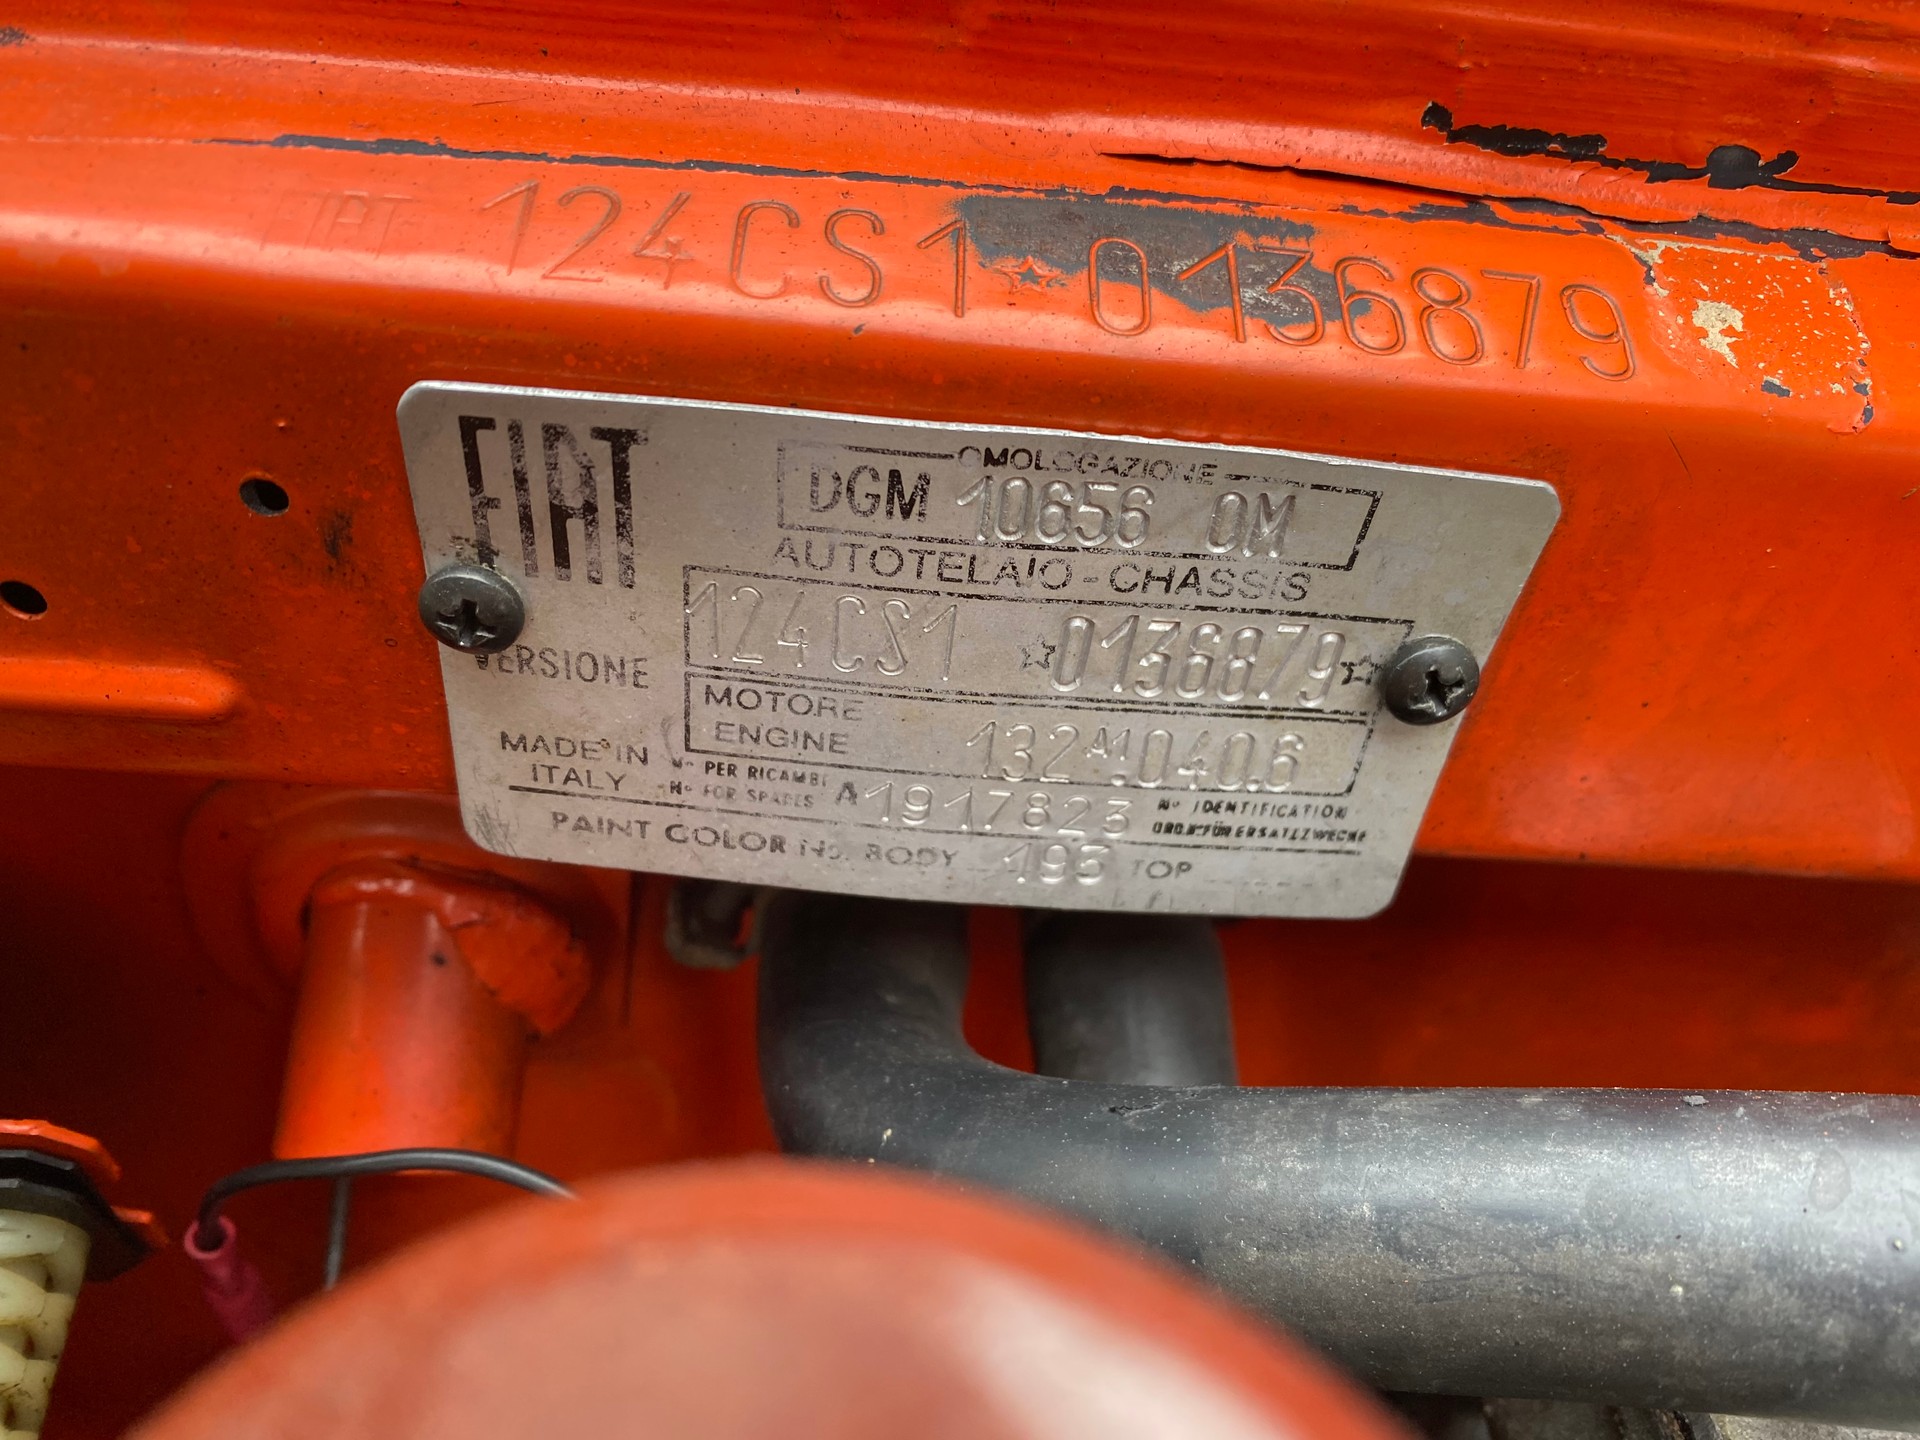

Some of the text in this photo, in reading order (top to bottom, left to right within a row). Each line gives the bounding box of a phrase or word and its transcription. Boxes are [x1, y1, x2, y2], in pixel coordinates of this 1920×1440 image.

[480, 179, 966, 318] 124CS1
[1088, 237, 1635, 381] 0136879
[958, 446, 1218, 486] OMOLOGAZIONE
[458, 415, 649, 589] FIAT
[809, 465, 932, 523] DGM
[956, 475, 1155, 549] 10656
[770, 537, 1074, 590] AUTOTELAIO
[1110, 562, 1312, 602] CHASSIS
[684, 581, 1347, 708] 124CS1 0136879
[704, 684, 864, 722] MOTORE
[500, 731, 649, 767] MADE IN
[714, 720, 851, 755] ENGINE
[531, 762, 628, 792] ITALY
[704, 760, 738, 778] PER
[703, 782, 737, 801] FOR
[746, 787, 815, 809] SPARES
[864, 781, 1133, 836] 1917823
[1192, 799, 1349, 820] IDENTIFICATION
[551, 810, 652, 840] PAINT
[664, 822, 786, 854] COLOR
[865, 842, 959, 868] BODY
[1131, 859, 1193, 880] TOP
